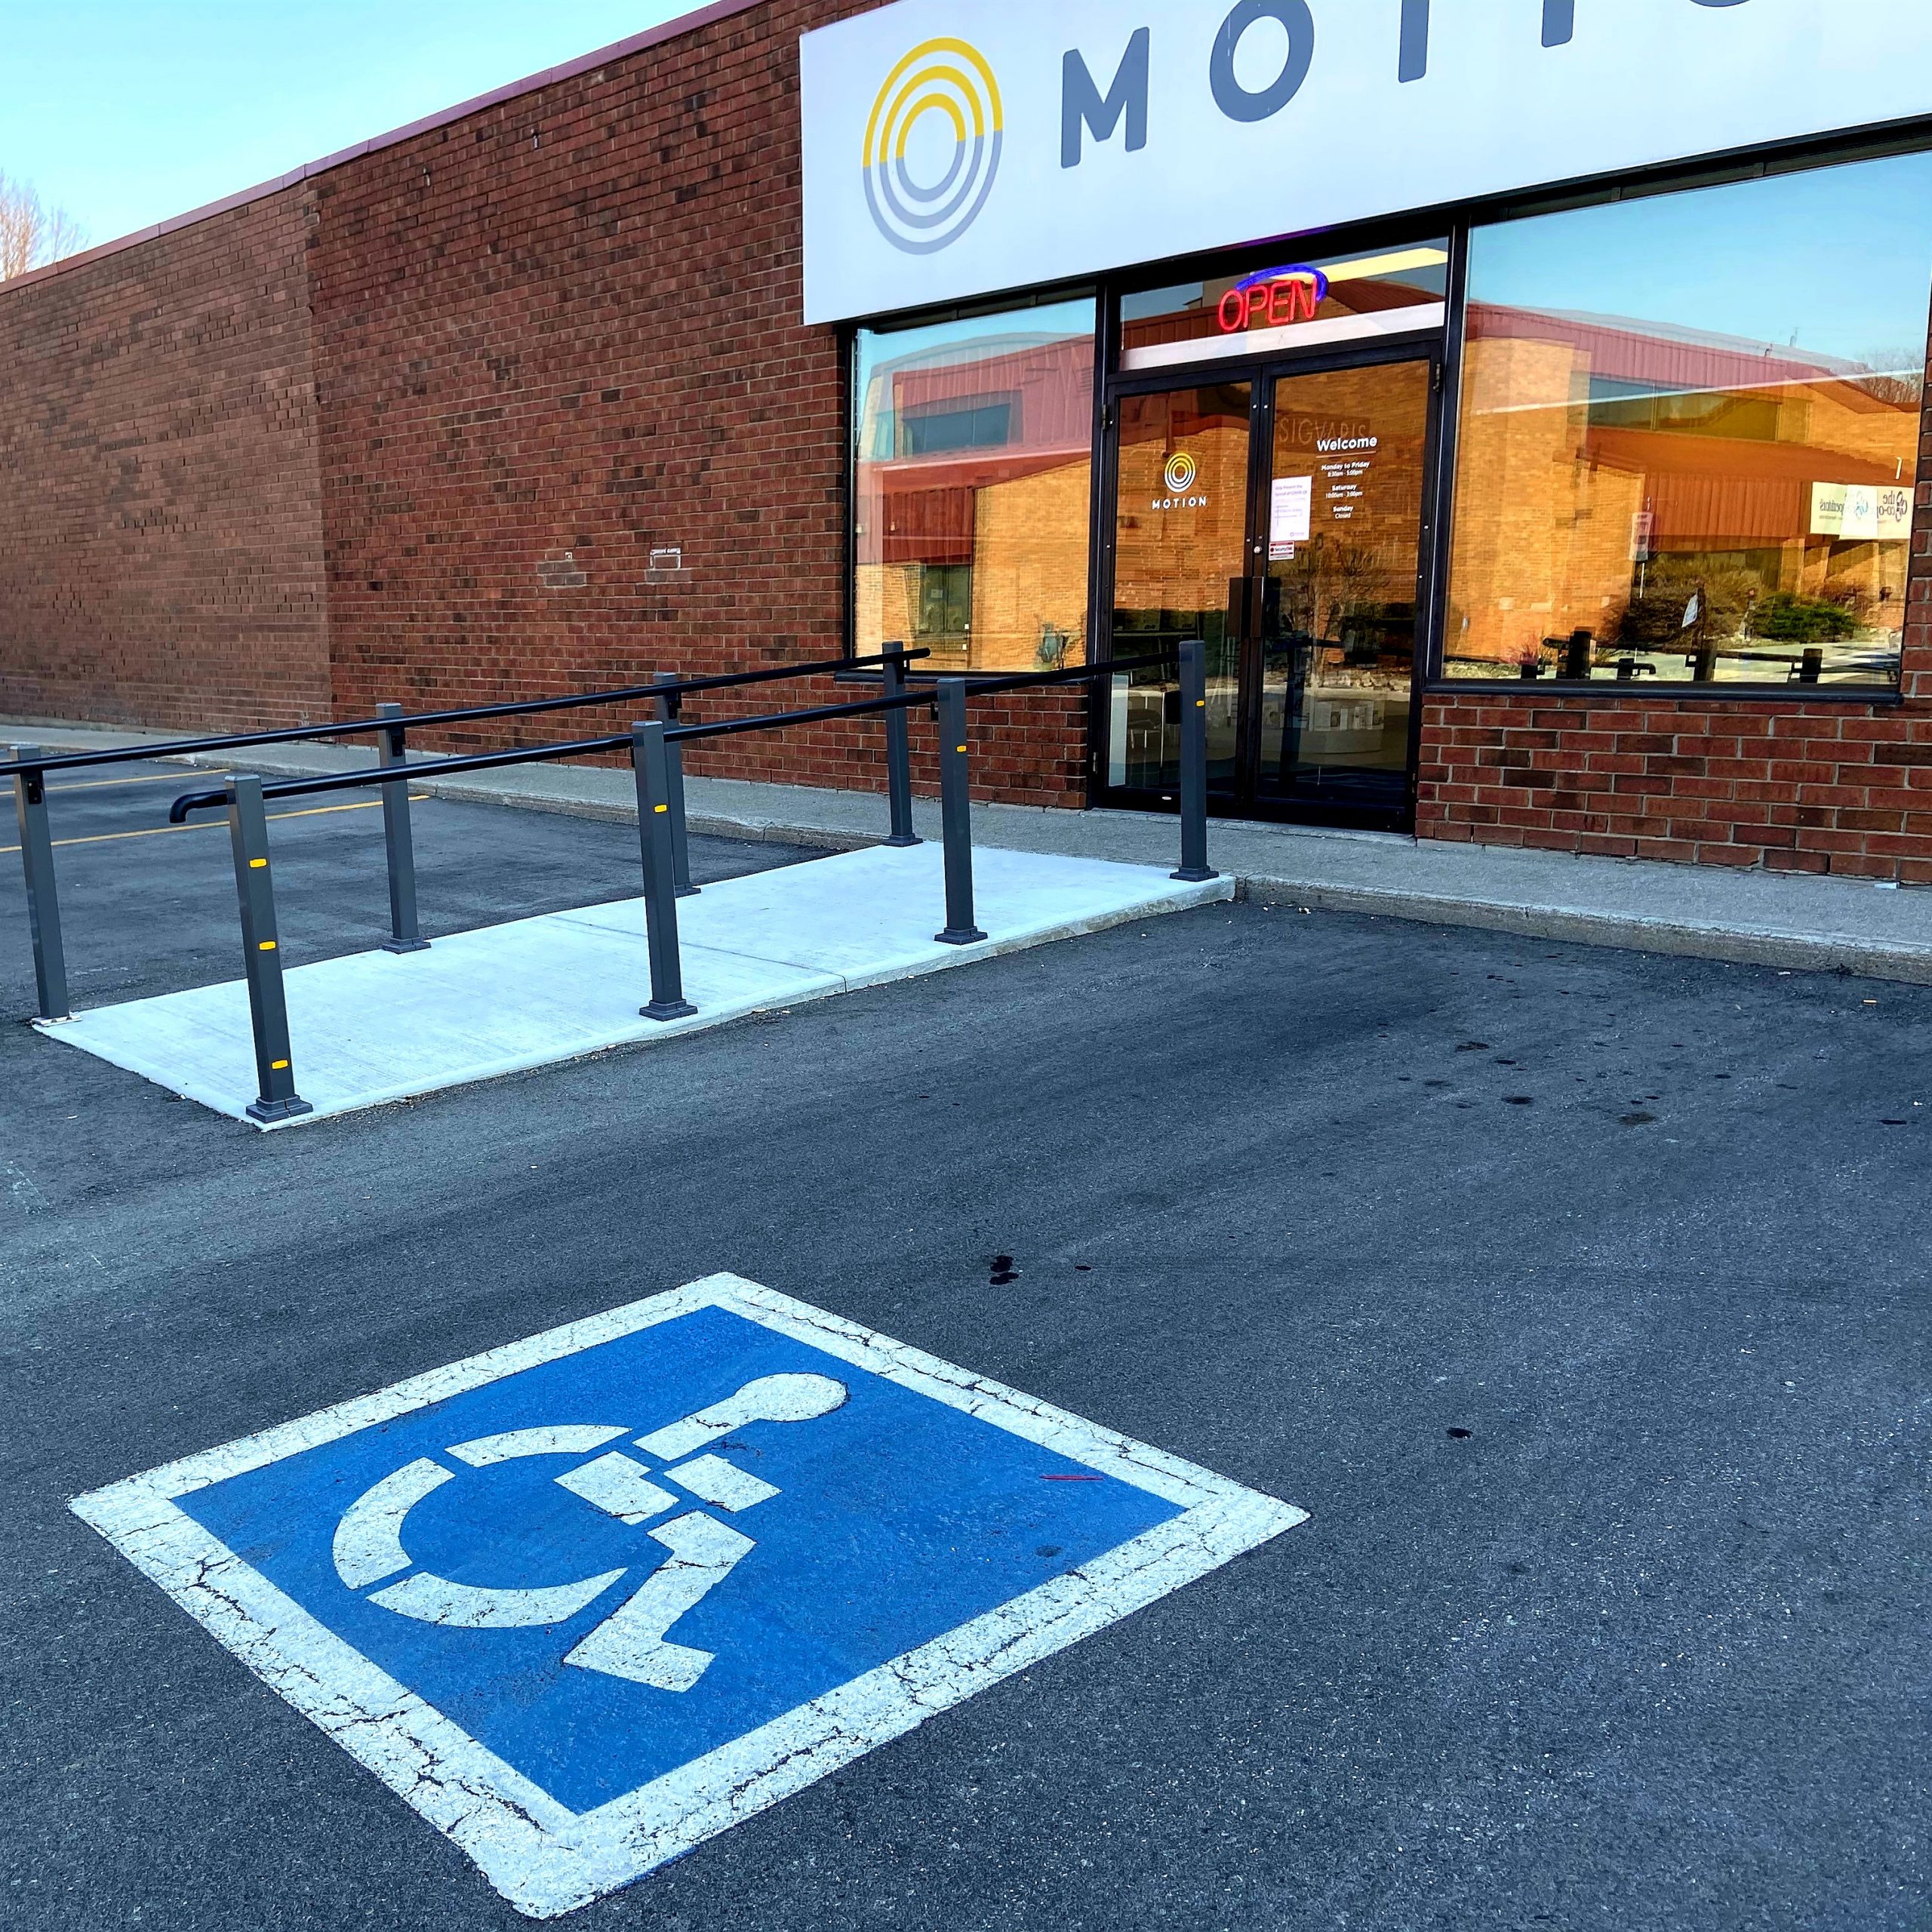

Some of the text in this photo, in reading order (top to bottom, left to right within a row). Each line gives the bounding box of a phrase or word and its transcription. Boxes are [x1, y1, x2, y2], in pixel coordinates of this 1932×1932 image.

[1219, 278, 1318, 331] OPEN
[1316, 436, 1378, 452] Welcome
[1152, 496, 1207, 510] MOTION
